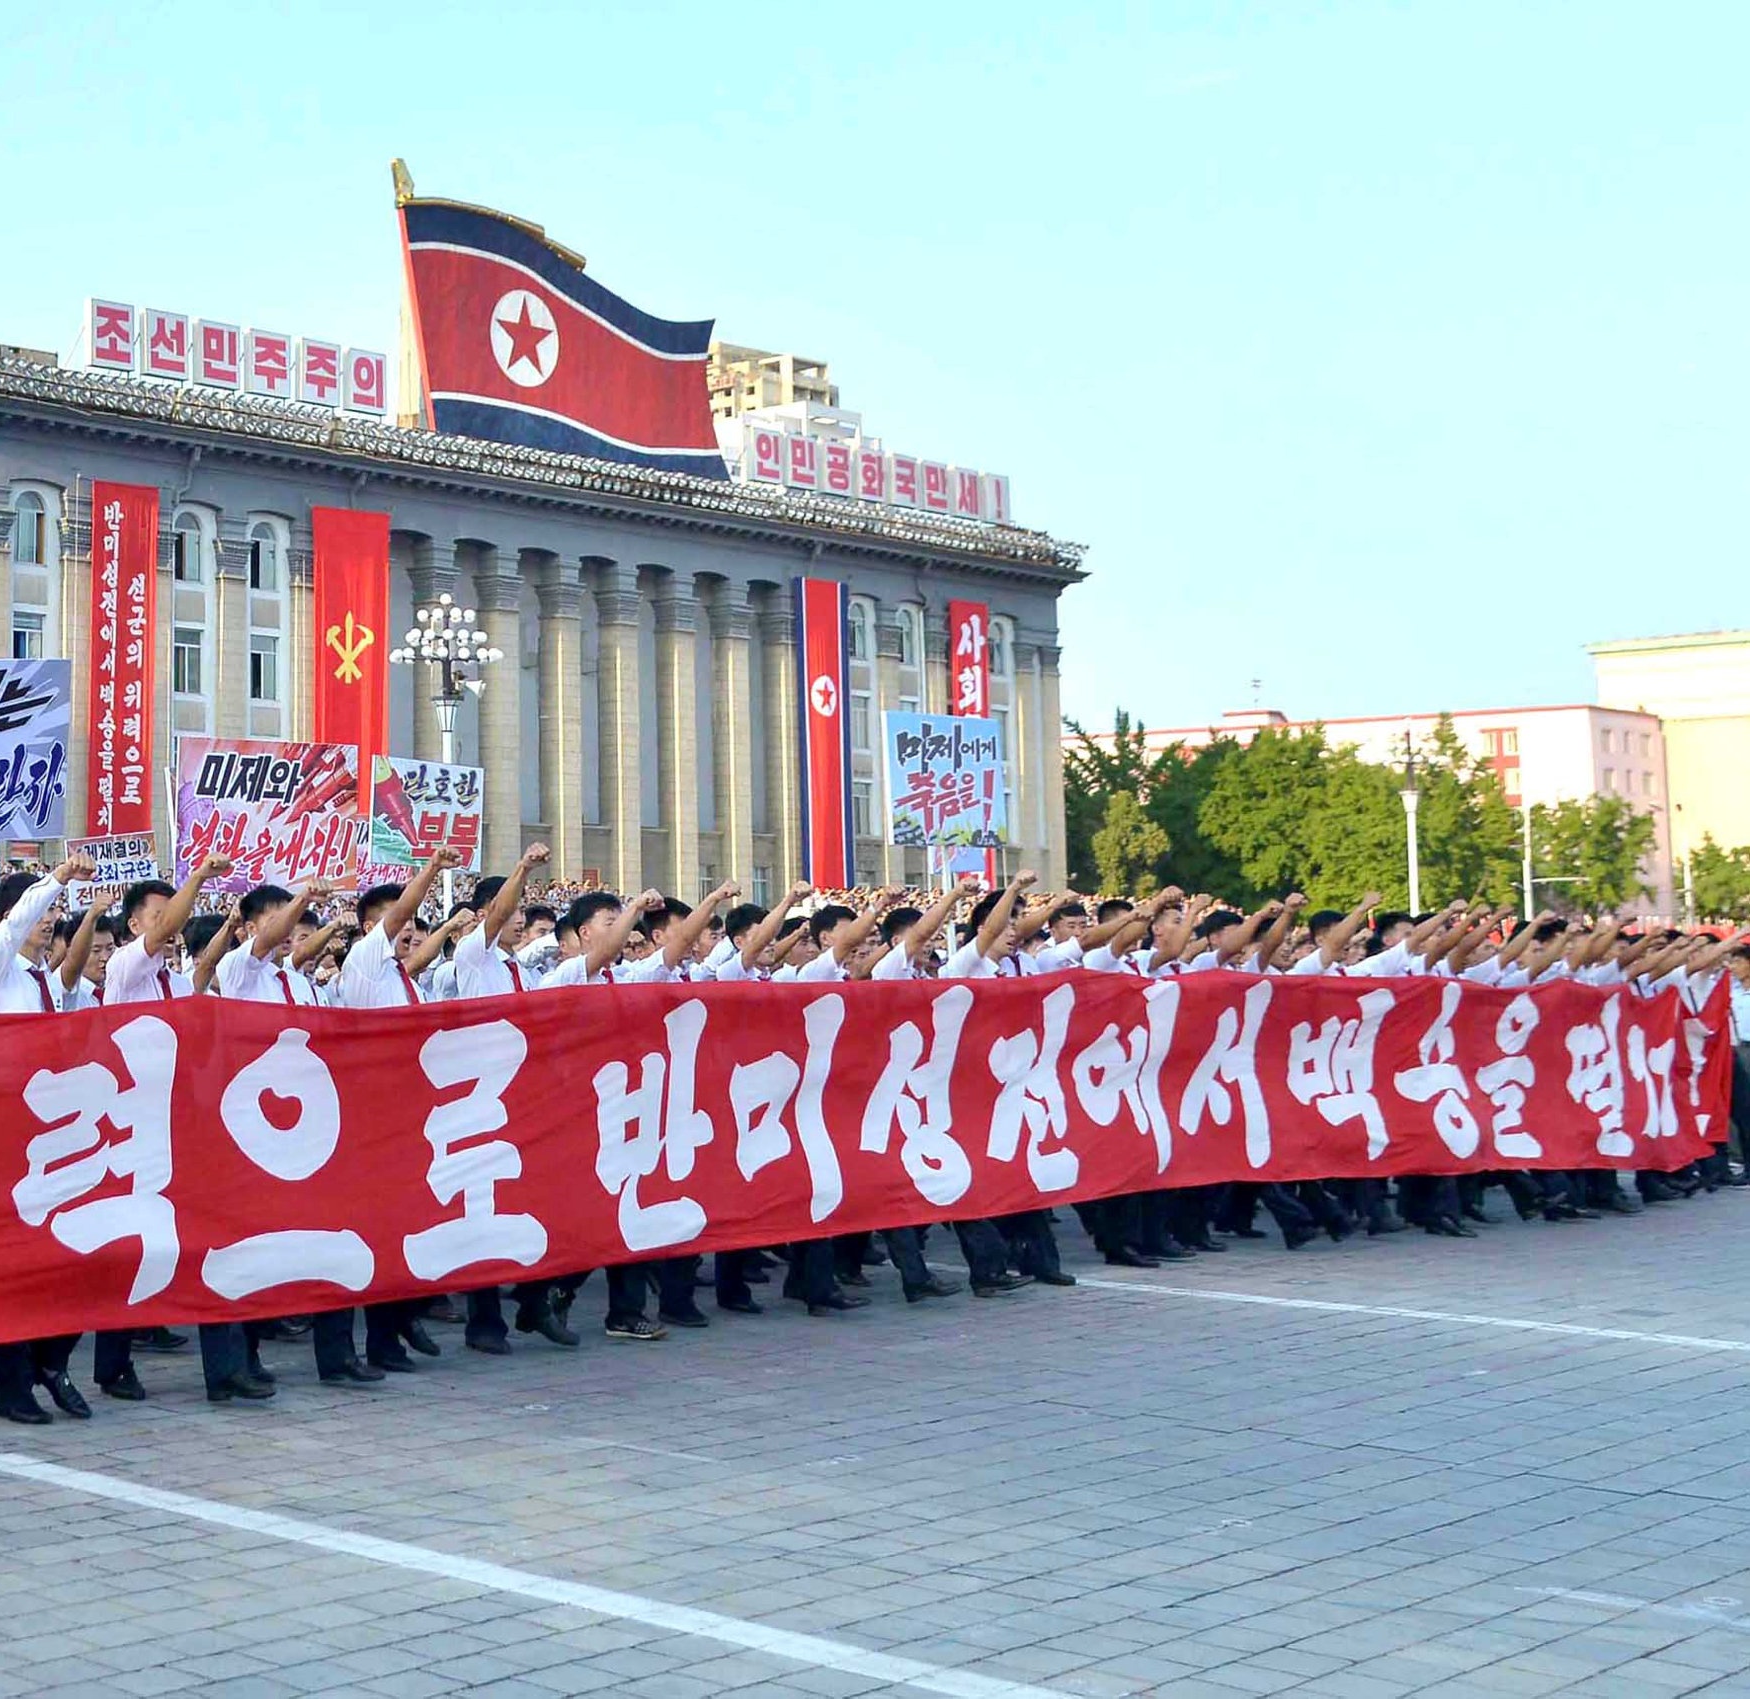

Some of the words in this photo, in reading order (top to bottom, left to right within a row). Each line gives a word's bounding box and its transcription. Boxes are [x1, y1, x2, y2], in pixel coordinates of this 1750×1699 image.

[95, 305, 384, 409] 조선민주주의
[126, 572, 147, 669] 선군의
[957, 613, 986, 717] 사회
[119, 680, 145, 805] 위력으로
[194, 752, 304, 804] 미제와
[896, 722, 996, 775] 미제에게
[403, 764, 480, 809] 단호한
[894, 769, 996, 838] 죽음을!
[411, 811, 481, 869] 보복
[593, 979, 1272, 1250] 반미성전에서
[1286, 981, 1544, 1161] 백승을
